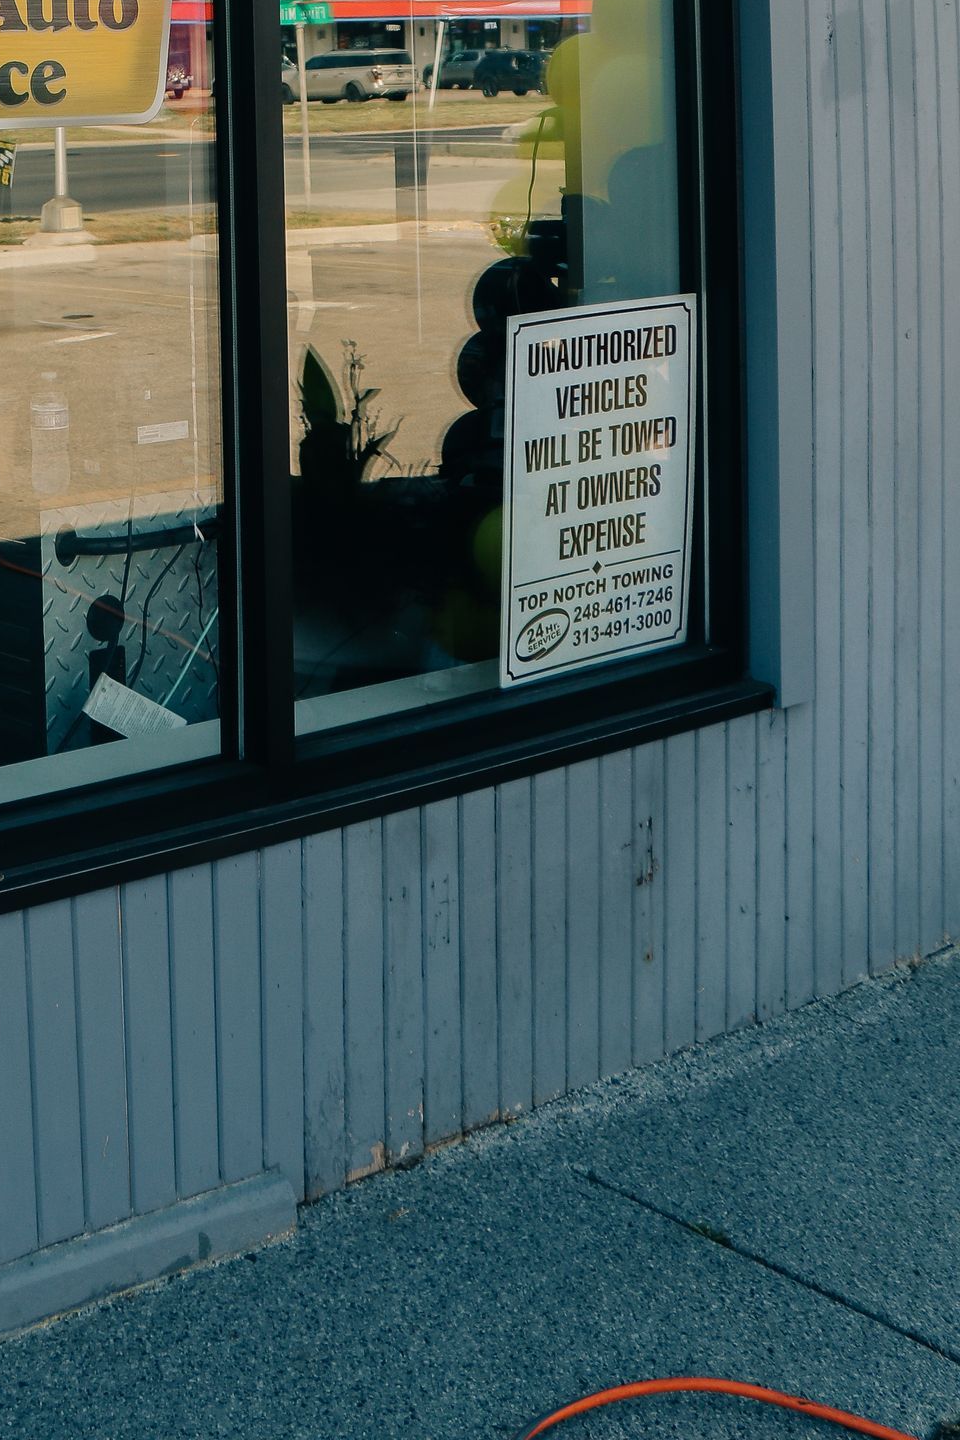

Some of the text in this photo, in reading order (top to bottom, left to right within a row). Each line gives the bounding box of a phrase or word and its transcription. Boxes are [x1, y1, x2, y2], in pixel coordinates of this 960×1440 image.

[528, 324, 676, 377] UNAUTHORIZED
[556, 374, 647, 419] VEHICLES
[525, 416, 677, 473] WILL BE TOWED
[545, 464, 662, 516] AT OWNERS
[559, 512, 646, 560] EXPENSE
[518, 564, 673, 612] TOP NOTCH TOWING
[574, 586, 673, 623] 248-461-7246
[527, 623, 560, 644] 24 Hr.
[528, 630, 561, 653] SERVICE
[573, 609, 671, 646] 313-491-3000
